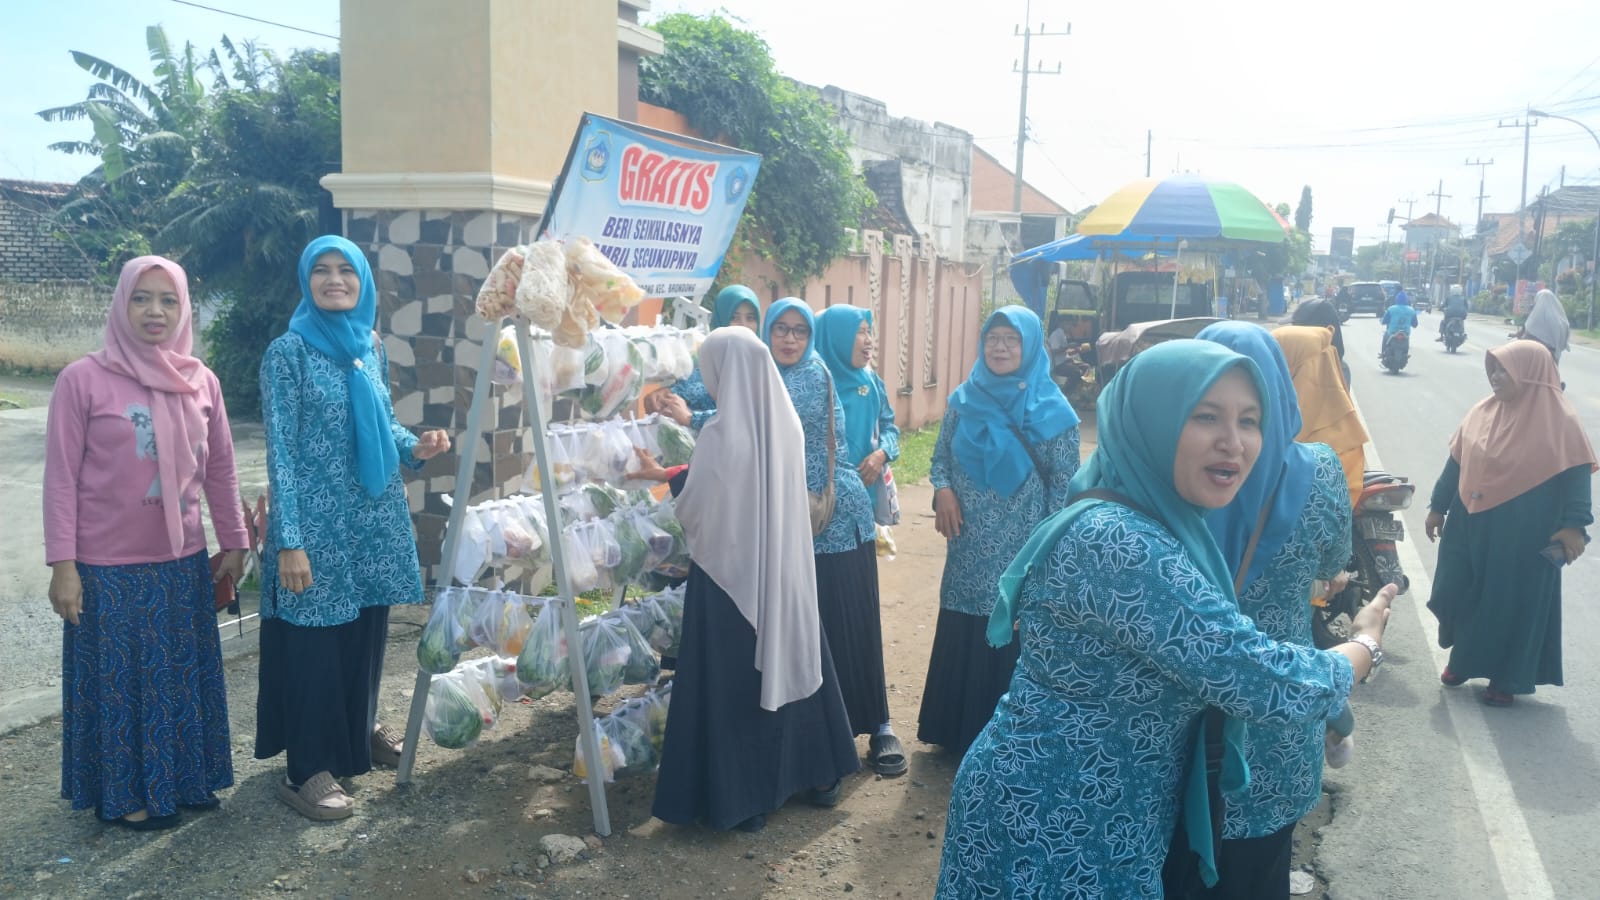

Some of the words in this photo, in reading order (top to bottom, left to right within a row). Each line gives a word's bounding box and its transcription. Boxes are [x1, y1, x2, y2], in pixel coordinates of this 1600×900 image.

[620, 146, 716, 210] GRATIS
[602, 216, 633, 239] BERI
[633, 219, 702, 245] SEIKHLASNYA
[593, 243, 631, 268] MBIL
[632, 247, 698, 270] SECUKUPNYA
